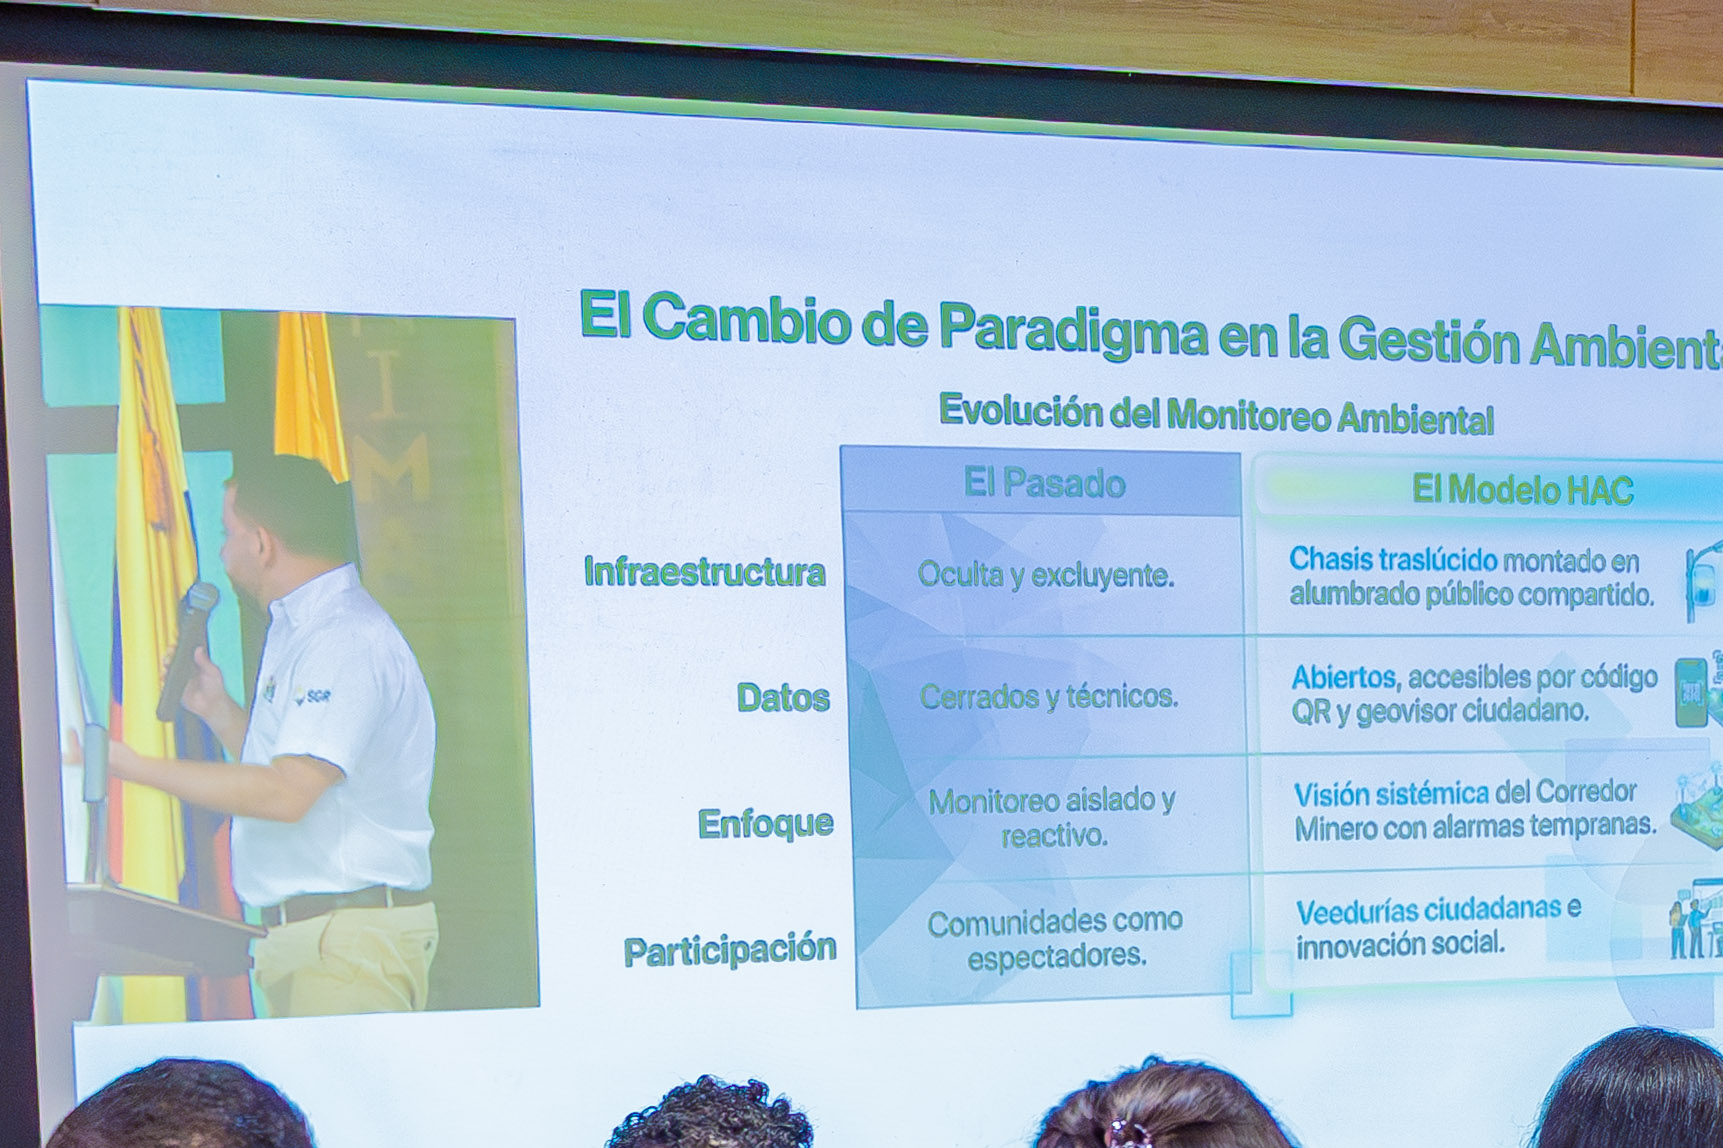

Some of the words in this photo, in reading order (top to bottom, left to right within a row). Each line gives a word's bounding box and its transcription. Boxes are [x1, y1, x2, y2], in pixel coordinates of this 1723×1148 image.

[581, 288, 630, 337] El
[643, 291, 852, 345] Cambio
[861, 299, 929, 347] de
[940, 301, 1208, 363] Paradigma
[1220, 320, 1278, 357] en
[1288, 314, 1329, 359] la
[1339, 315, 1520, 365] Gestión
[940, 391, 1103, 427] Evolución
[1110, 396, 1160, 429] del
[1168, 398, 1331, 432] Monitoreo
[1337, 401, 1495, 436] Ambiental
[964, 465, 994, 497] El
[1004, 464, 1126, 499] Pasado
[1413, 472, 1441, 503] El
[1449, 473, 1561, 505] Modelo
[1567, 476, 1635, 506] HAC
[585, 556, 826, 587] Infraestructura
[917, 559, 1004, 589] Oculta
[1011, 567, 1025, 592] y
[1031, 561, 1174, 592] excluyente.
[1289, 546, 1374, 572] Chasis
[1379, 547, 1498, 572] traslúcido
[1503, 550, 1606, 573] montado
[1611, 554, 1640, 573] en
[1289, 581, 1420, 606] alumbrado
[1425, 581, 1514, 611] público
[1518, 582, 1655, 612] compartido.
[1292, 664, 1403, 693] Abiertos,
[1408, 664, 1531, 689] accesibles
[1537, 669, 1576, 695] por
[1580, 662, 1658, 694] código
[737, 682, 831, 712] Datos
[920, 682, 1039, 711] Cerrados
[1046, 689, 1061, 715] y
[1067, 681, 1179, 710] técnicos.
[1292, 697, 1331, 727] QR
[1336, 703, 1350, 729] y
[1357, 698, 1457, 729] geovisor
[1462, 697, 1590, 723] ciudadano.
[929, 788, 1060, 815] Monitoreo
[1066, 786, 1155, 813] aislado
[1160, 790, 1176, 816] y
[1295, 781, 1370, 808] Visión
[1376, 780, 1489, 807] sistémica
[1495, 779, 1531, 804] del
[1536, 778, 1637, 804] Corredor
[699, 808, 834, 842] Enfoque
[1001, 822, 1108, 849] reactivo.
[1295, 815, 1379, 843] Minero
[1383, 821, 1427, 841] con
[1432, 813, 1525, 839] alarmas
[1530, 811, 1657, 841] tempranas.
[928, 909, 1107, 938] Comunidades
[1113, 910, 1184, 932] como
[1297, 898, 1419, 926] Veedurías
[1424, 896, 1562, 922] ciudadanas
[1567, 899, 1582, 918] e
[624, 931, 837, 970] Participación
[967, 942, 1147, 975] espectadores.
[1297, 931, 1426, 961] innovación
[1432, 927, 1505, 955] social.
